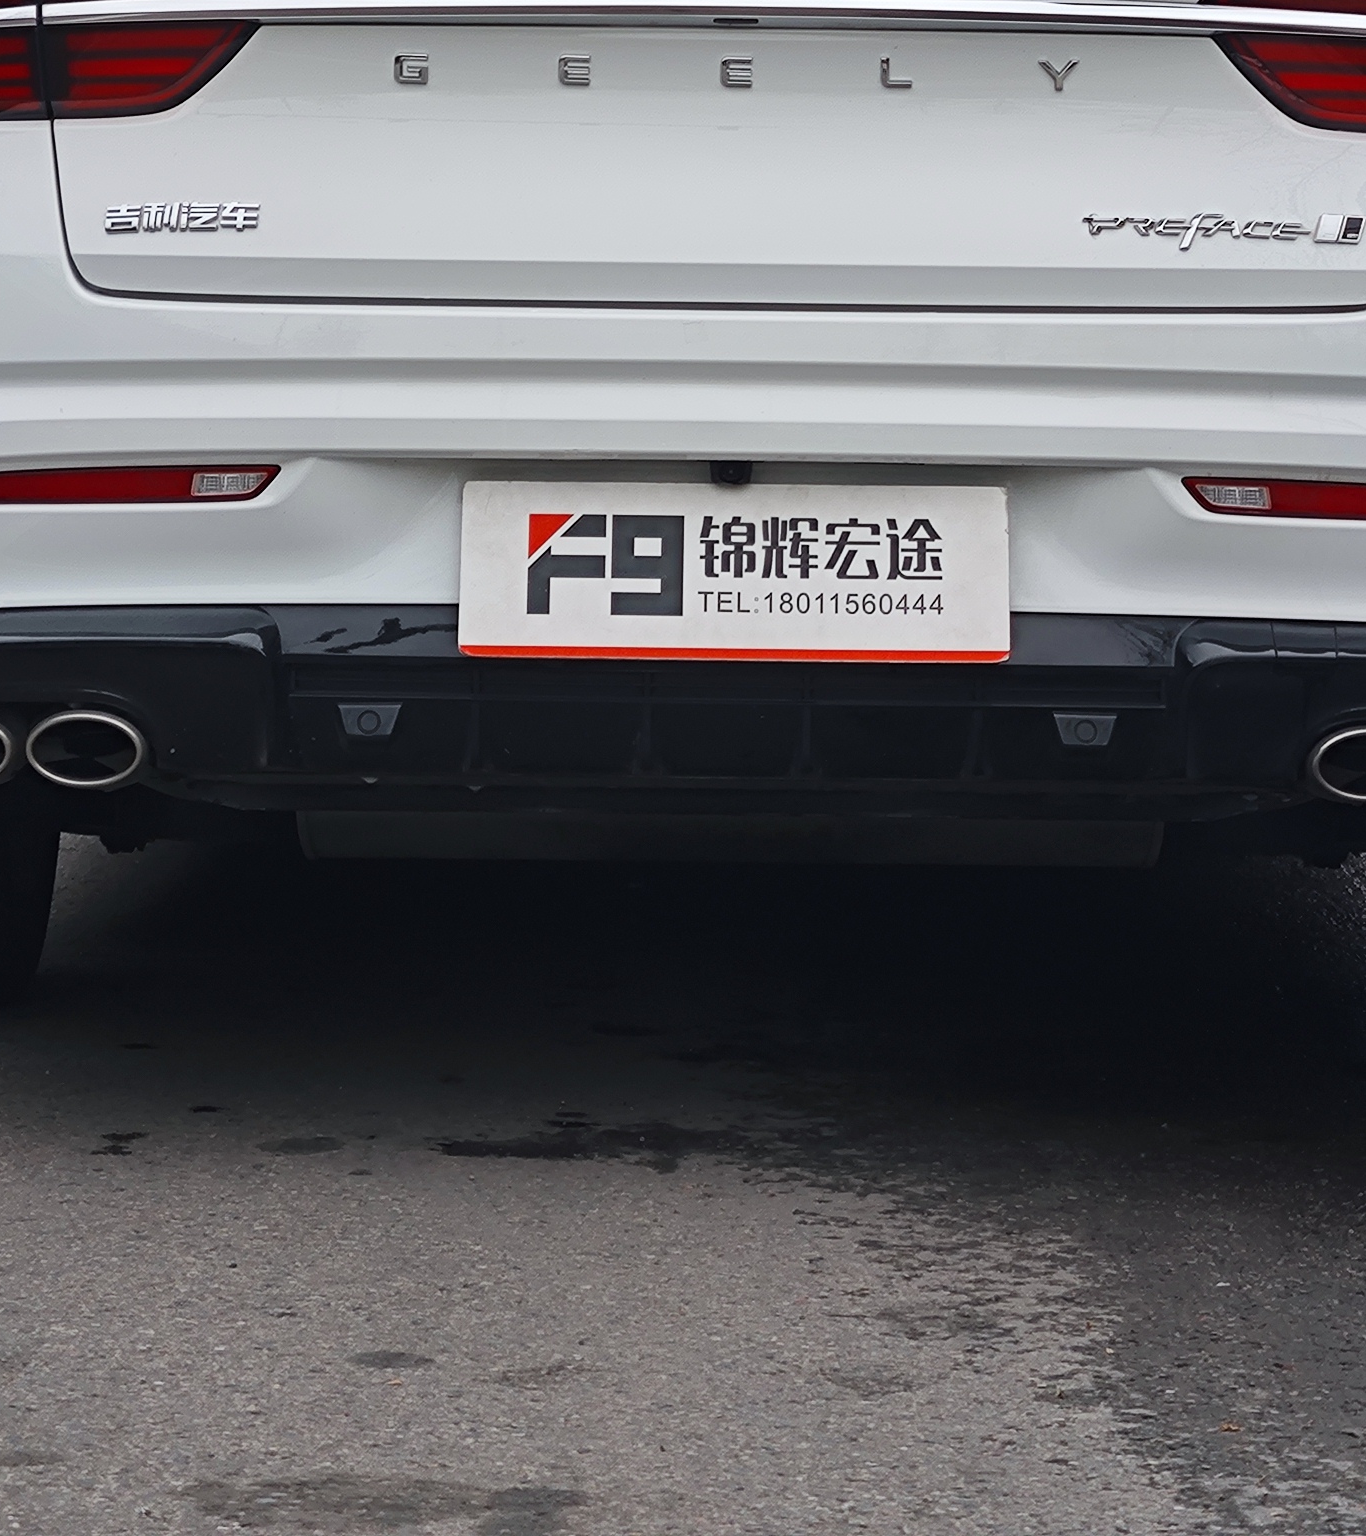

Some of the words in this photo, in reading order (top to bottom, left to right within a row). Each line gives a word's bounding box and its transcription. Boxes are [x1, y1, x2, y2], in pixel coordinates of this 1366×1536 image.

[393, 53, 1079, 91] GEELY
[104, 201, 260, 234] 吉利汽车
[527, 513, 685, 616] F9
[699, 516, 943, 580] 锦辉宏途
[698, 590, 944, 616] TEL:18011560444
